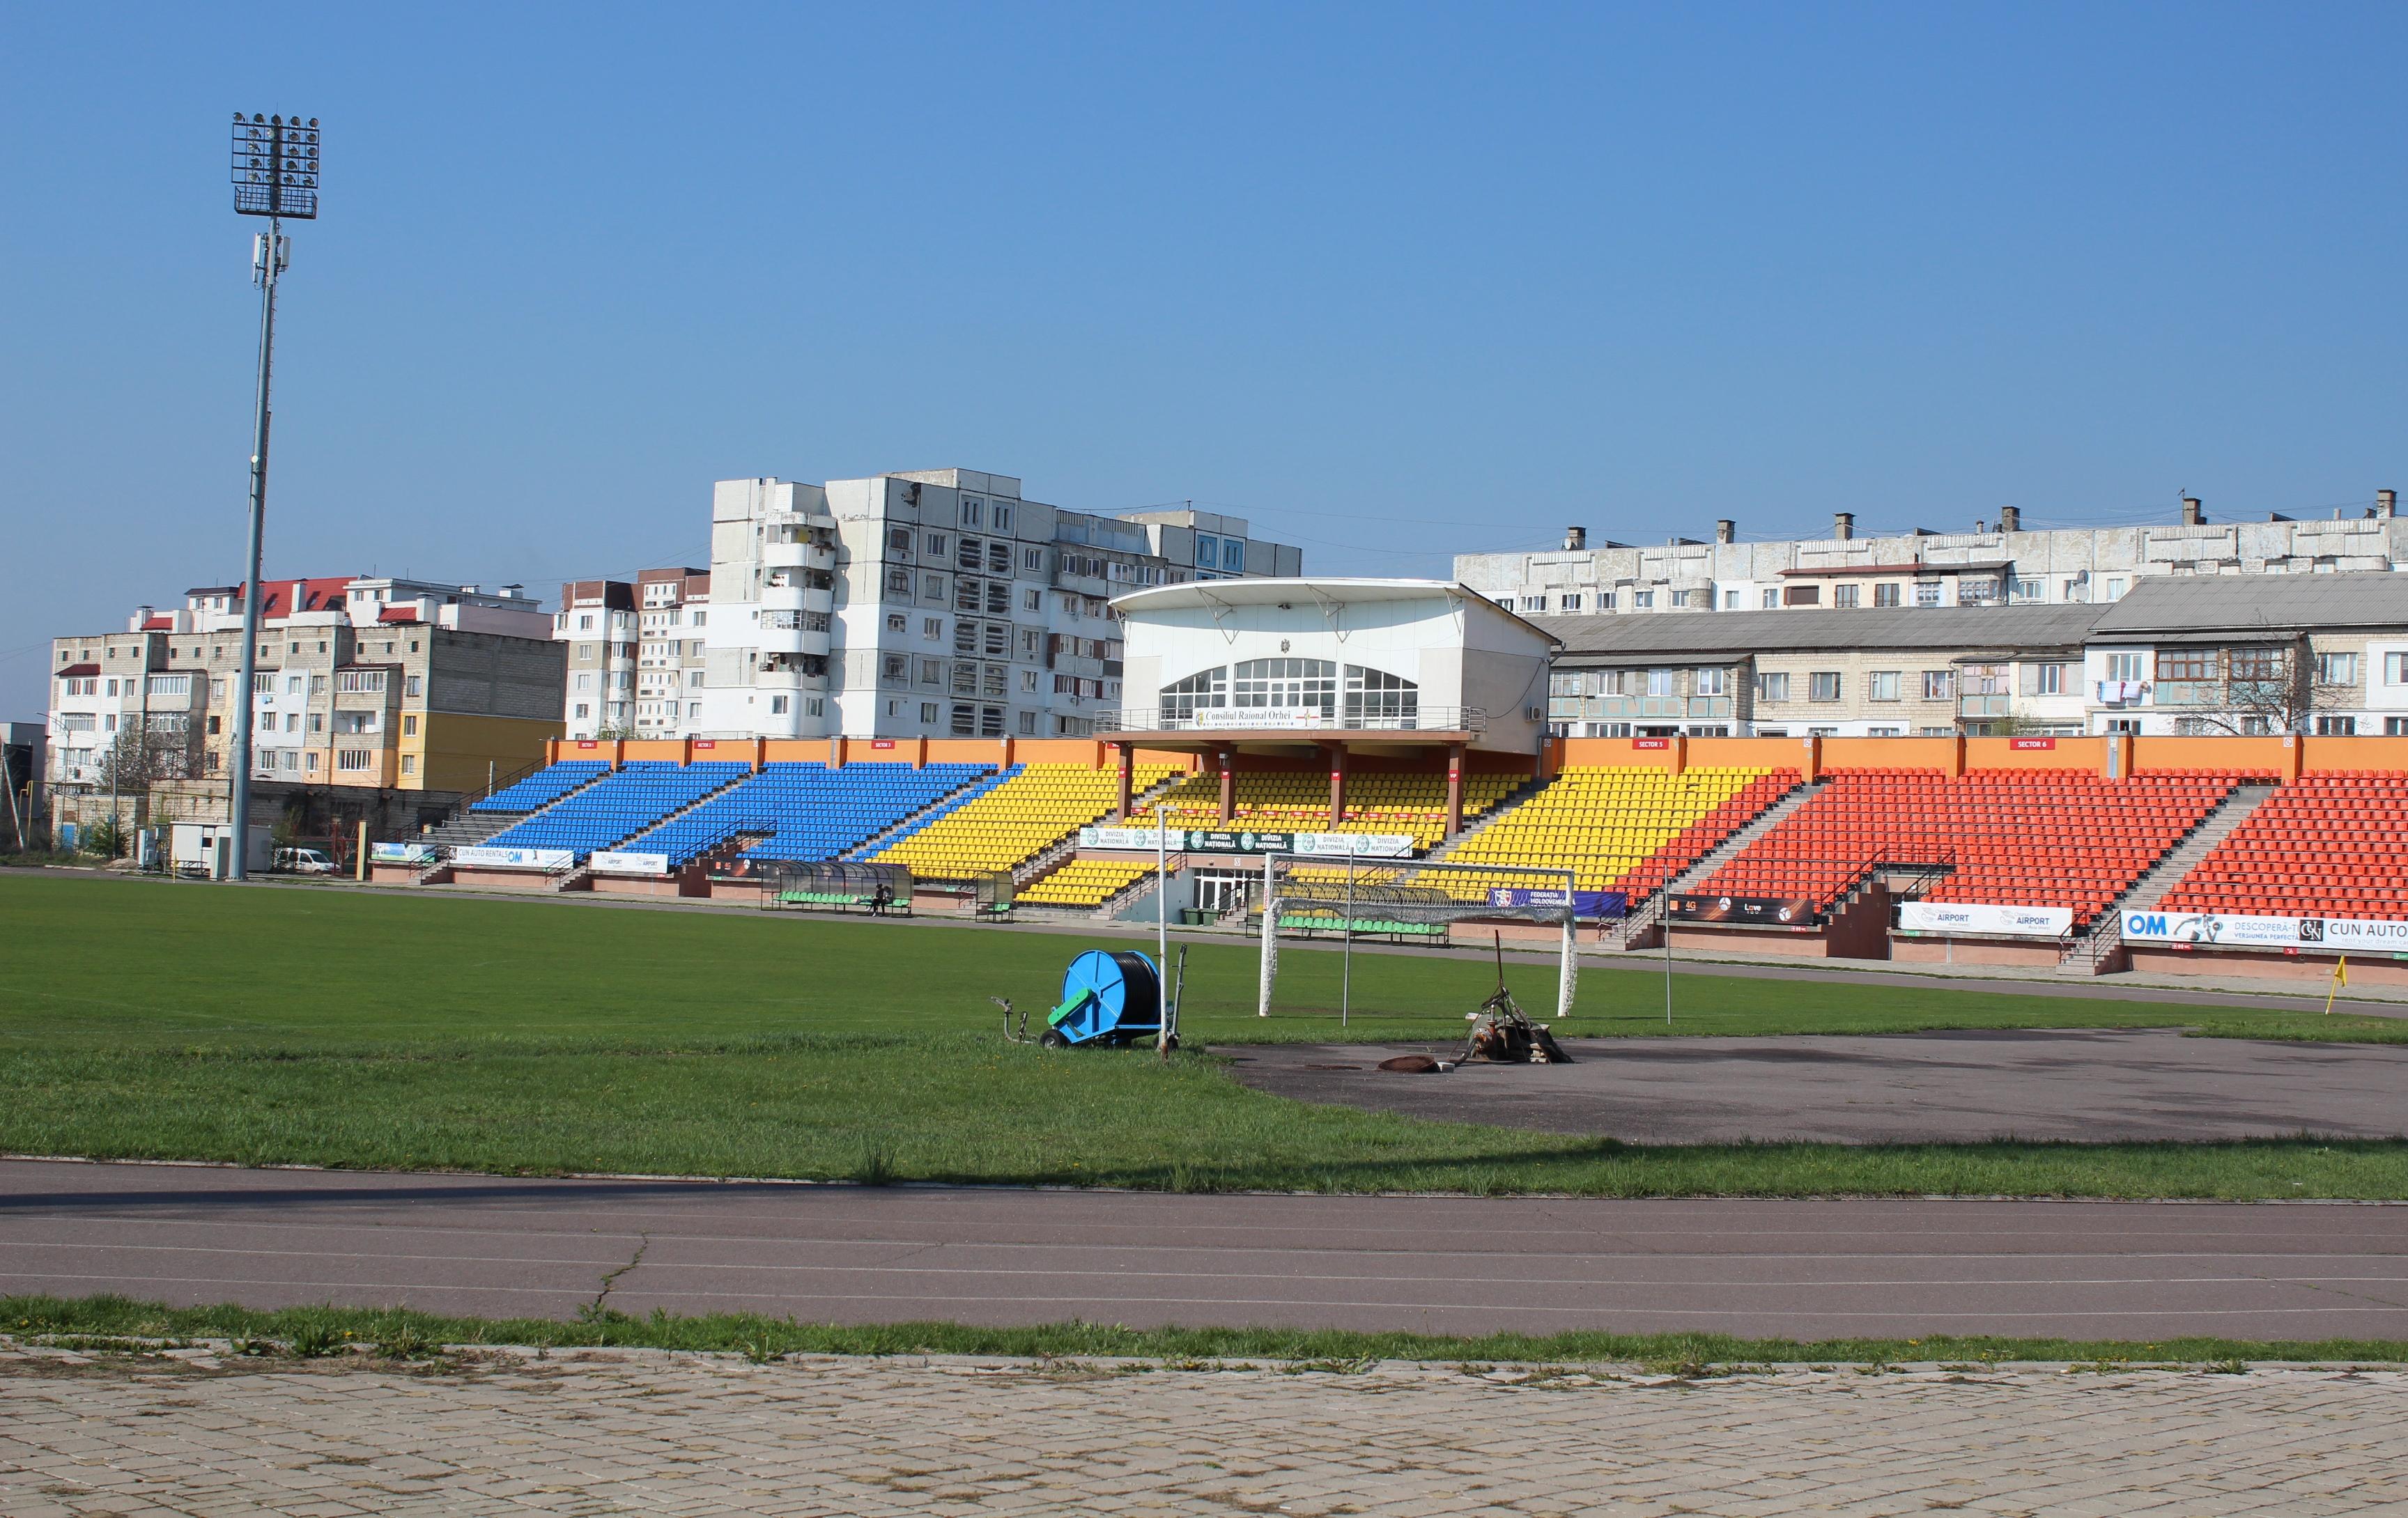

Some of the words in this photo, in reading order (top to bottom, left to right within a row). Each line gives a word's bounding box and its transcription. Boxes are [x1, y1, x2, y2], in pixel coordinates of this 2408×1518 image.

[1205, 711, 1237, 720] Consiliul
[1238, 711, 1267, 720] Raional
[1268, 710, 1290, 720] Orhei
[486, 849, 508, 858] RENTALS
[508, 851, 523, 863] OM
[1685, 901, 1696, 909] 4G
[1744, 903, 1761, 911] Love
[1938, 913, 1970, 922] AIRPORT
[2016, 917, 2050, 925] AIRPORT
[2127, 915, 2167, 936] OM
[2330, 923, 2361, 935] CUN
[2367, 924, 2407, 937] AUTO
